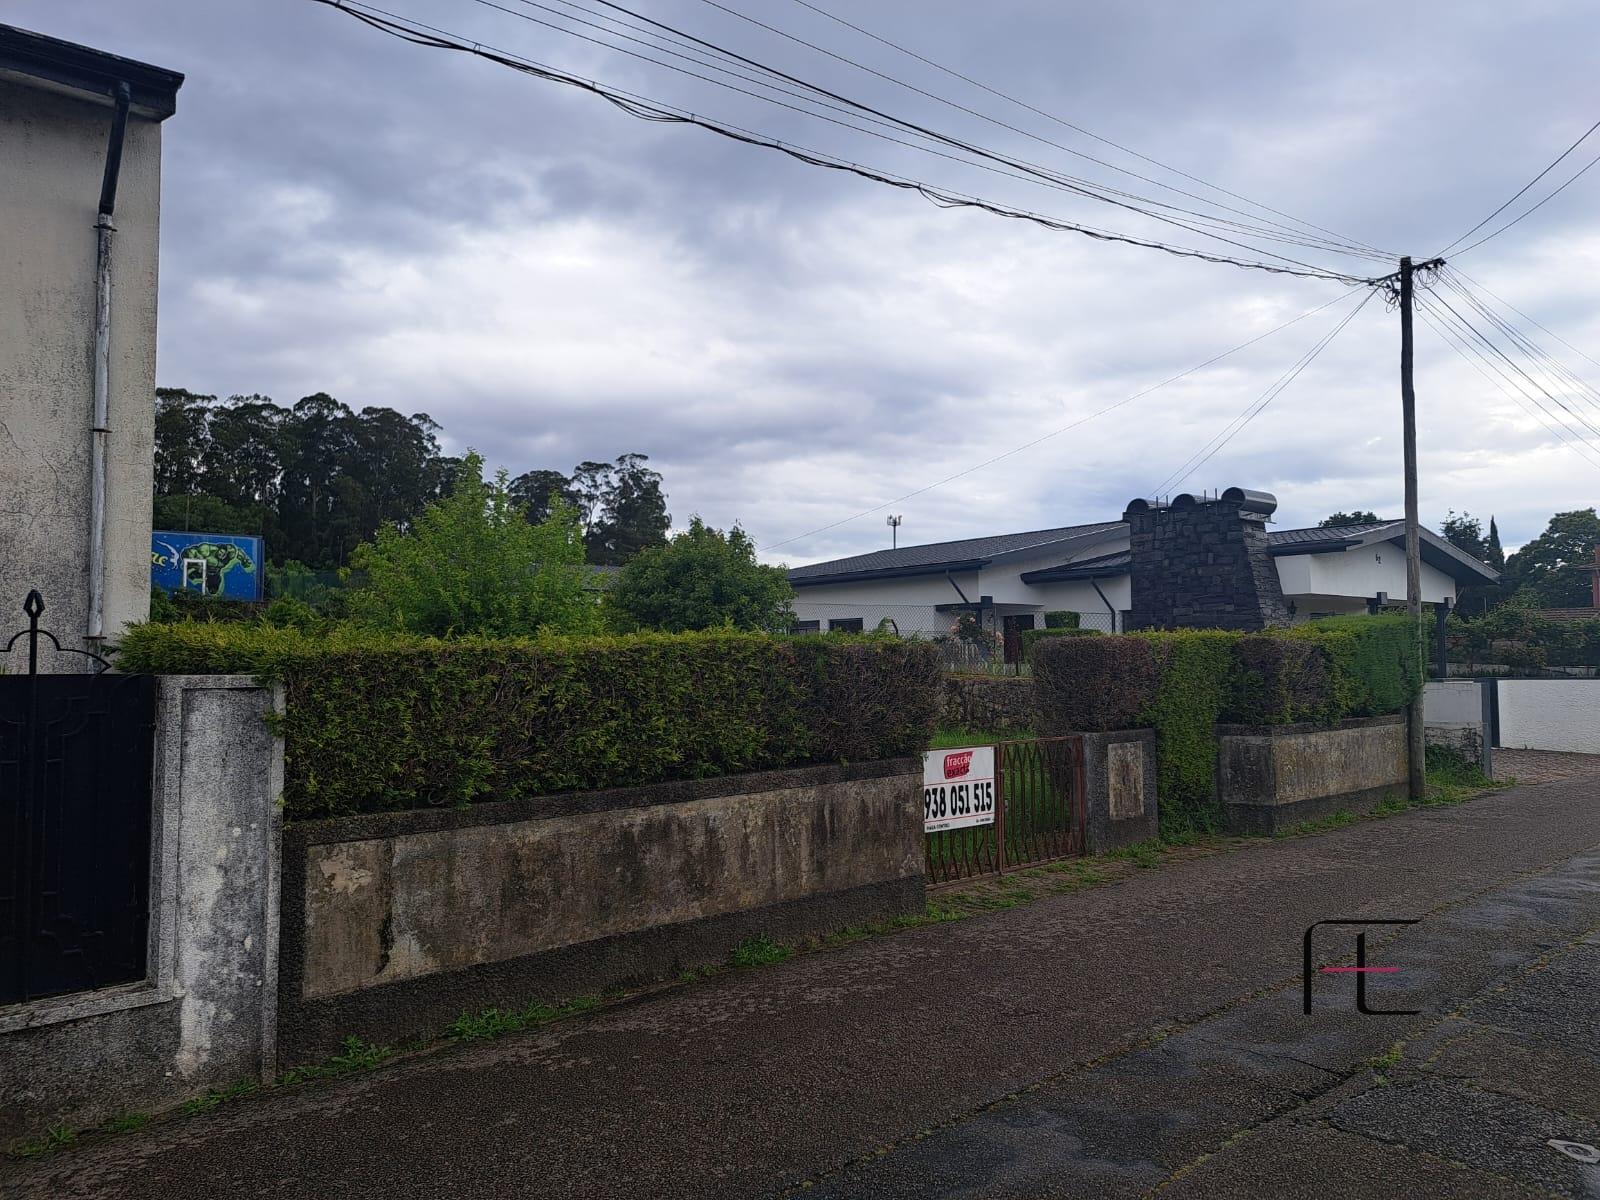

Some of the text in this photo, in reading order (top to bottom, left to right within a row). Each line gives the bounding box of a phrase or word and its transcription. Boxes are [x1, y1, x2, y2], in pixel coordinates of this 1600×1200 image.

[924, 782, 992, 819] 938 051 515
